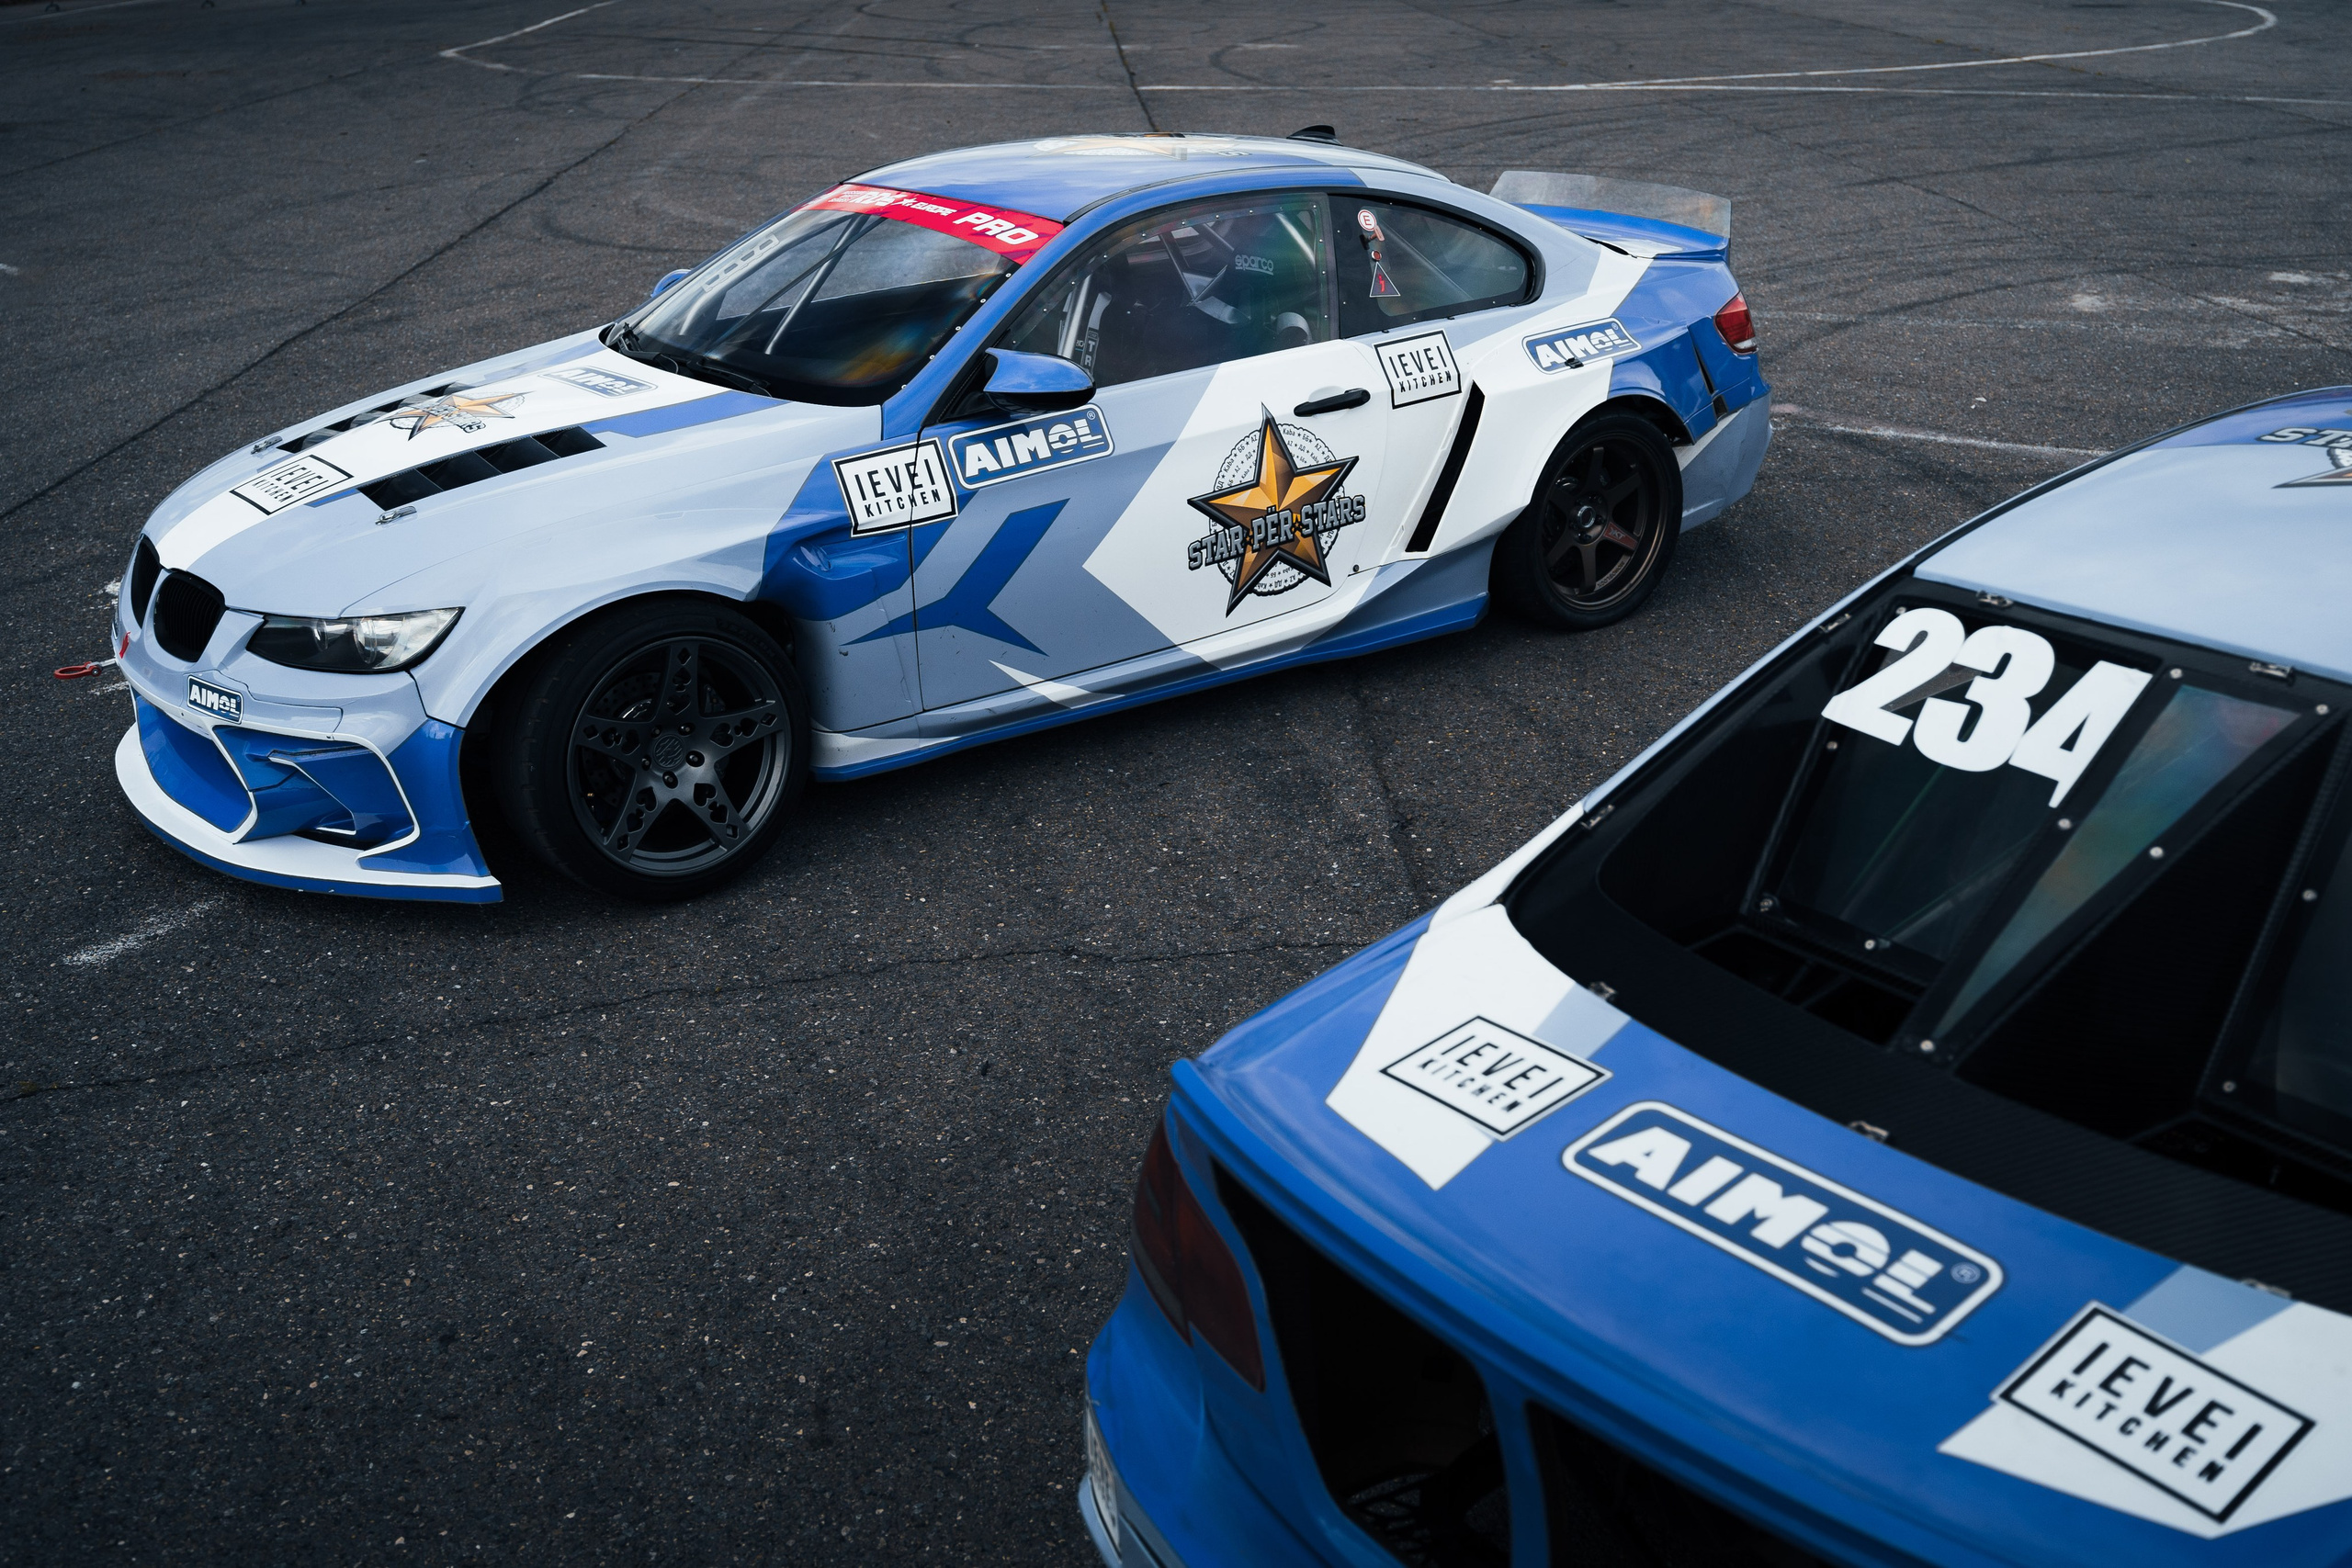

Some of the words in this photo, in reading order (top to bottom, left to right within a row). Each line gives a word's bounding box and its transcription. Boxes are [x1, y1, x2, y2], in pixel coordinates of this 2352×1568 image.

[953, 211, 1039, 244] PRO
[1363, 215, 1372, 226] E
[1534, 328, 1633, 368] AIMOL
[1398, 370, 1453, 393] KITCHEN
[966, 418, 1104, 478] AIMOL
[864, 488, 942, 518] KITCHEN
[1188, 524, 1245, 571] STAR
[1251, 504, 1295, 553] PËR
[1300, 494, 1366, 539] STARS
[190, 684, 240, 717] AIMOL
[1821, 607, 2154, 808] 234
[1417, 1058, 1522, 1113] KITCHEN
[1587, 1125, 1944, 1323] AIMOL
[2049, 1378, 2226, 1483] KITCHEN
